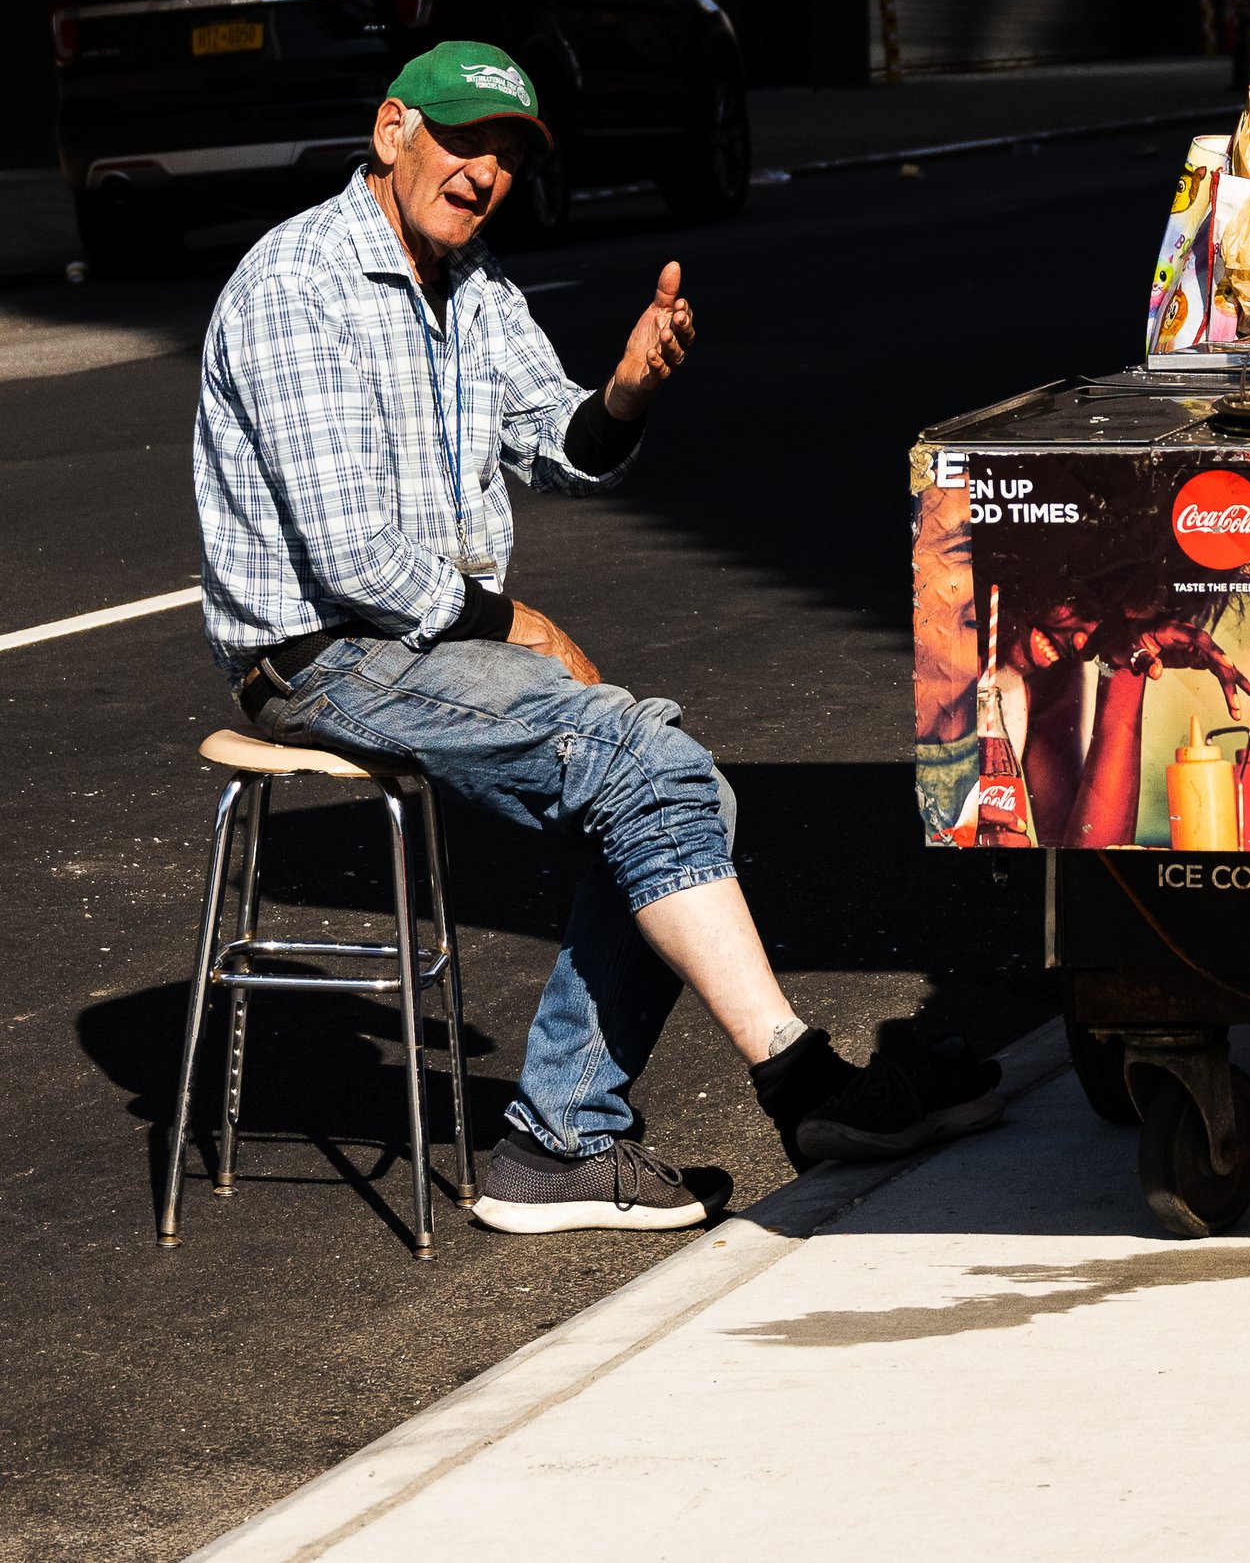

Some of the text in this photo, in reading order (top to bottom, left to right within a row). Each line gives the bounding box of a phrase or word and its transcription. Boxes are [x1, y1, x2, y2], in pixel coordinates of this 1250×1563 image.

[1000, 479, 1033, 499] UP
[1008, 503, 1080, 523] TIMES
[1173, 582, 1205, 592] TASTE
[1207, 582, 1228, 592] THE
[1158, 864, 1203, 888] ICE
